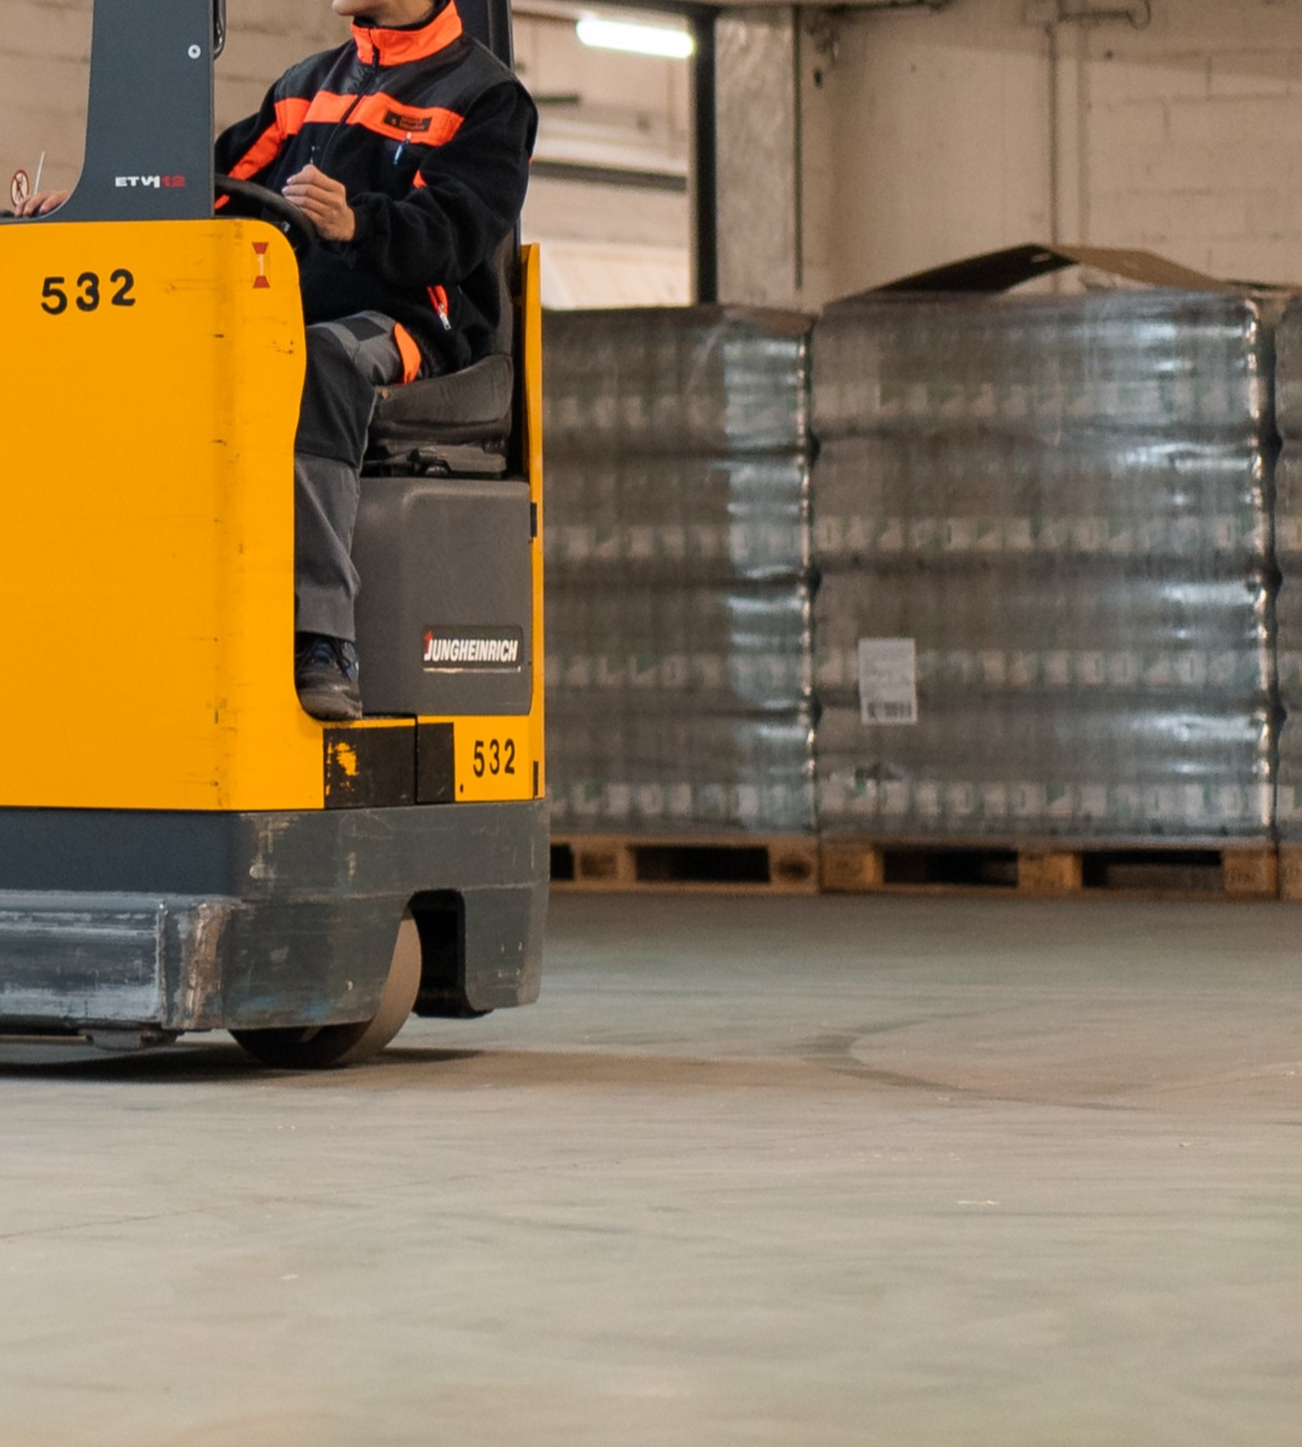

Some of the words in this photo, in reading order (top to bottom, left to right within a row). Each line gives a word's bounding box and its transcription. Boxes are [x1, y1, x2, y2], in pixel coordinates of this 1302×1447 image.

[41, 269, 136, 315] 532
[424, 632, 519, 662] JUNGHEINRICH
[473, 738, 516, 778] 532
